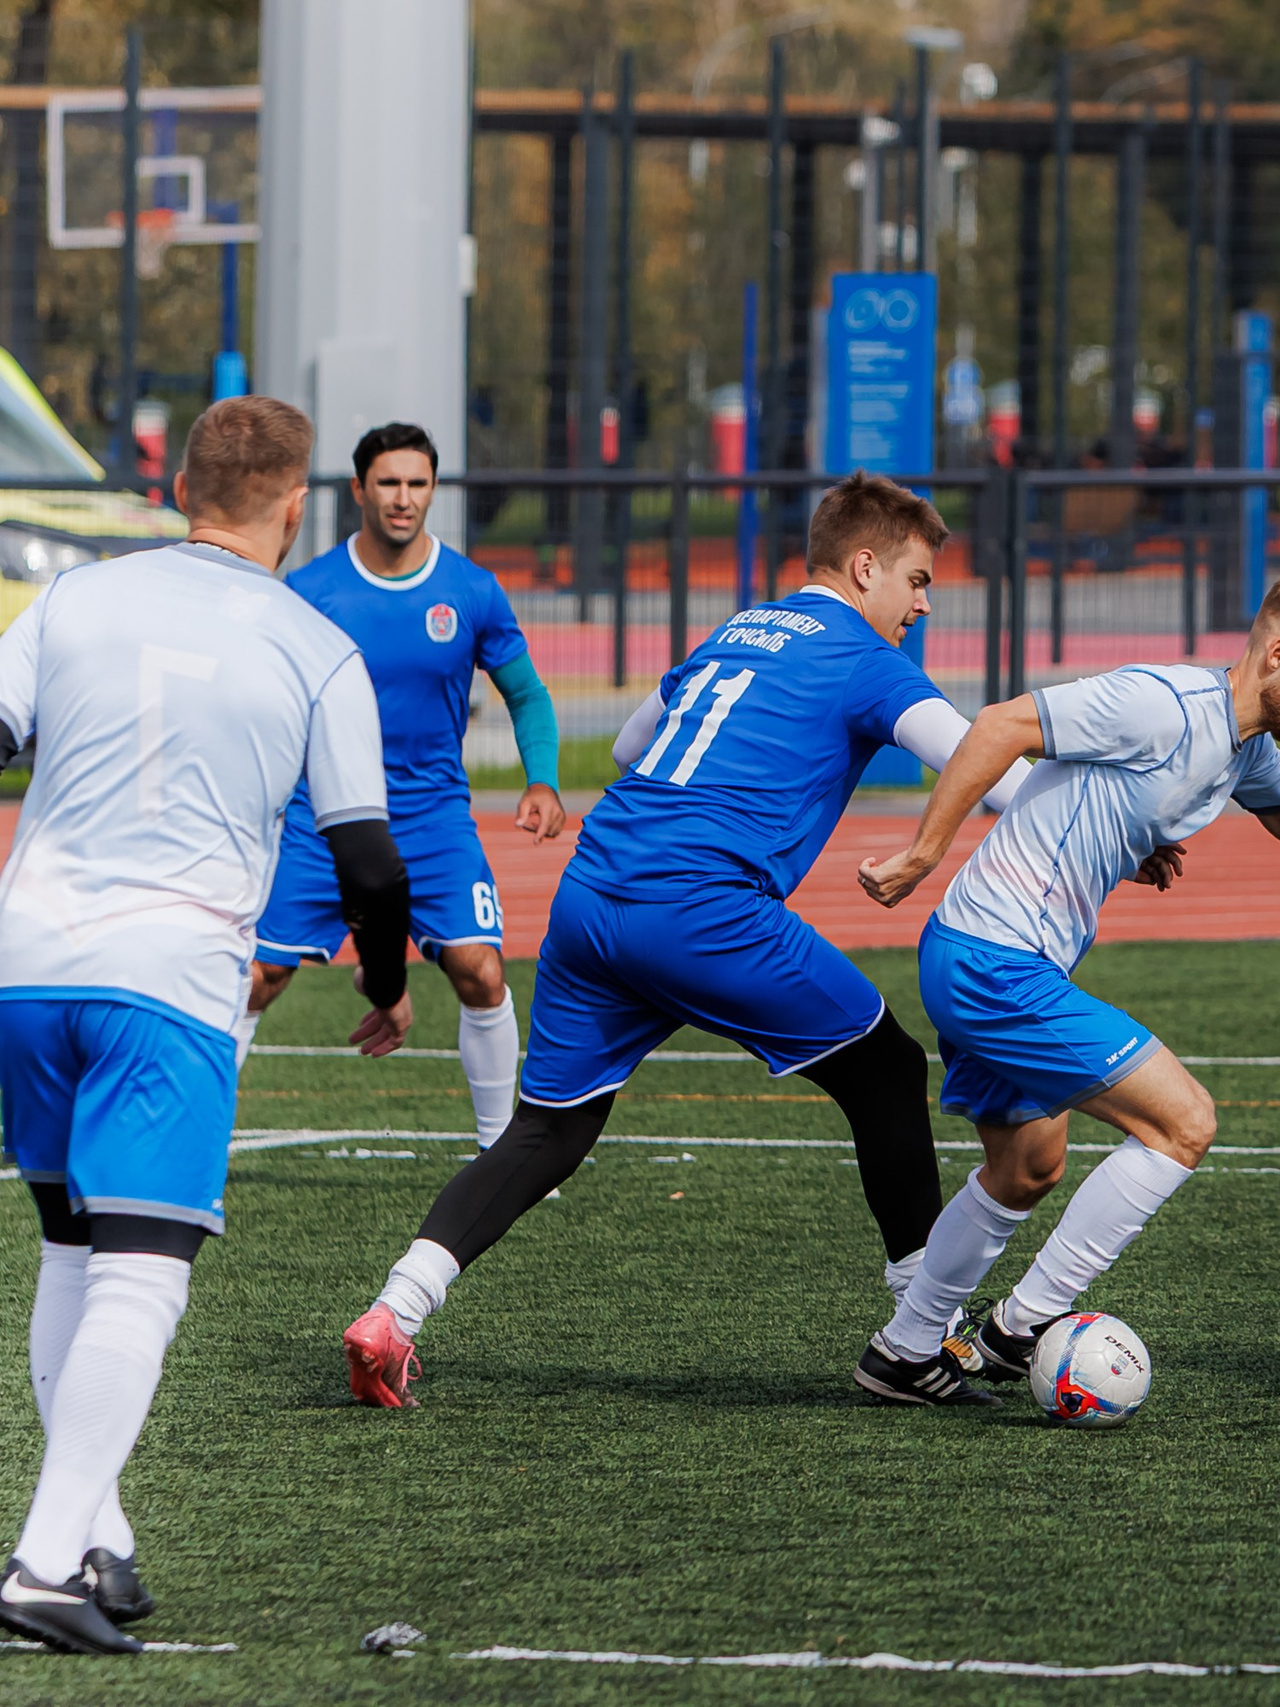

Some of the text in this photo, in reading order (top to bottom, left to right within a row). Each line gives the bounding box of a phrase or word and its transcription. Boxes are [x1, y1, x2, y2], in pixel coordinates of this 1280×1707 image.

[726, 609, 826, 636] ДЕПАРТАМЕНТ
[635, 660, 756, 787] 11
[1118, 1036, 1138, 1057] SPORT
[1104, 1334, 1145, 1373] DEMIX
